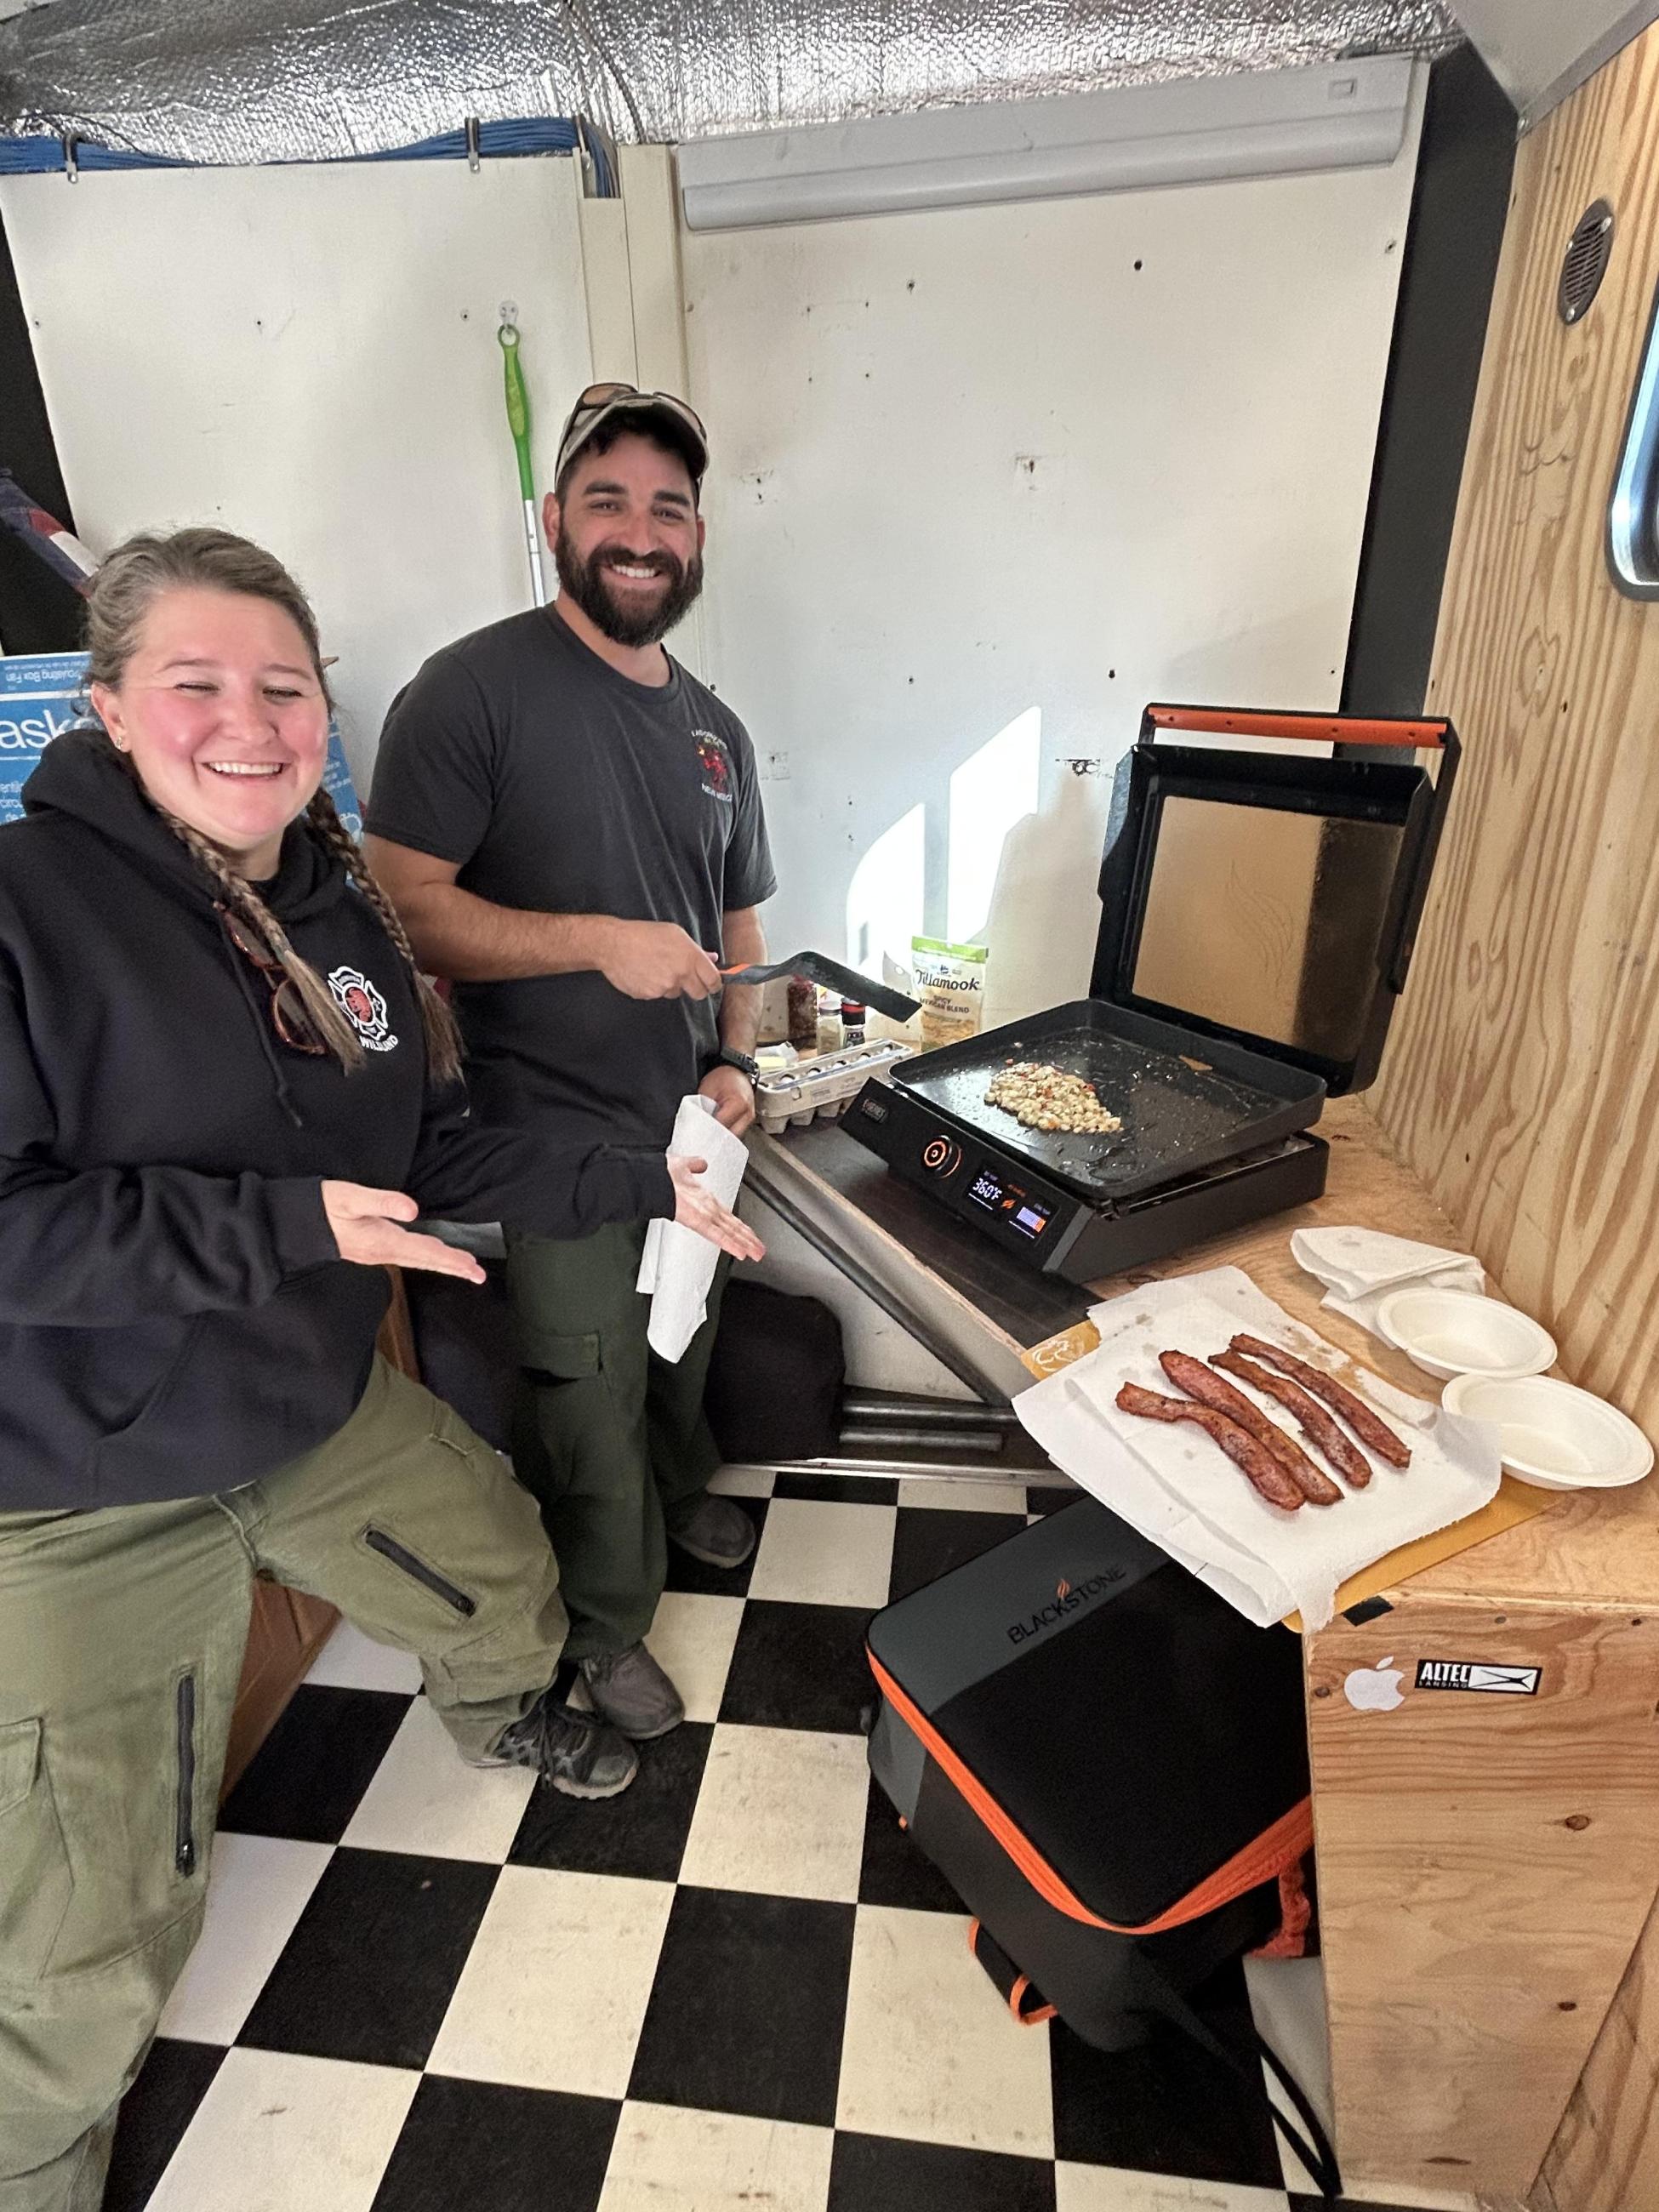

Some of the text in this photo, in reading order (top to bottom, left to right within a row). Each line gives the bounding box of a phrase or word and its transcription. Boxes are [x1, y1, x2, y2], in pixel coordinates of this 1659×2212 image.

[0, 710, 95, 750] ask
[915, 969, 980, 991] Tillamook
[946, 1004, 970, 1014] BLEND
[972, 1177, 1002, 1200] 360°F
[1007, 1569, 1126, 1645] BLACKSTONE
[1420, 1662, 1471, 1682] ALTEC
